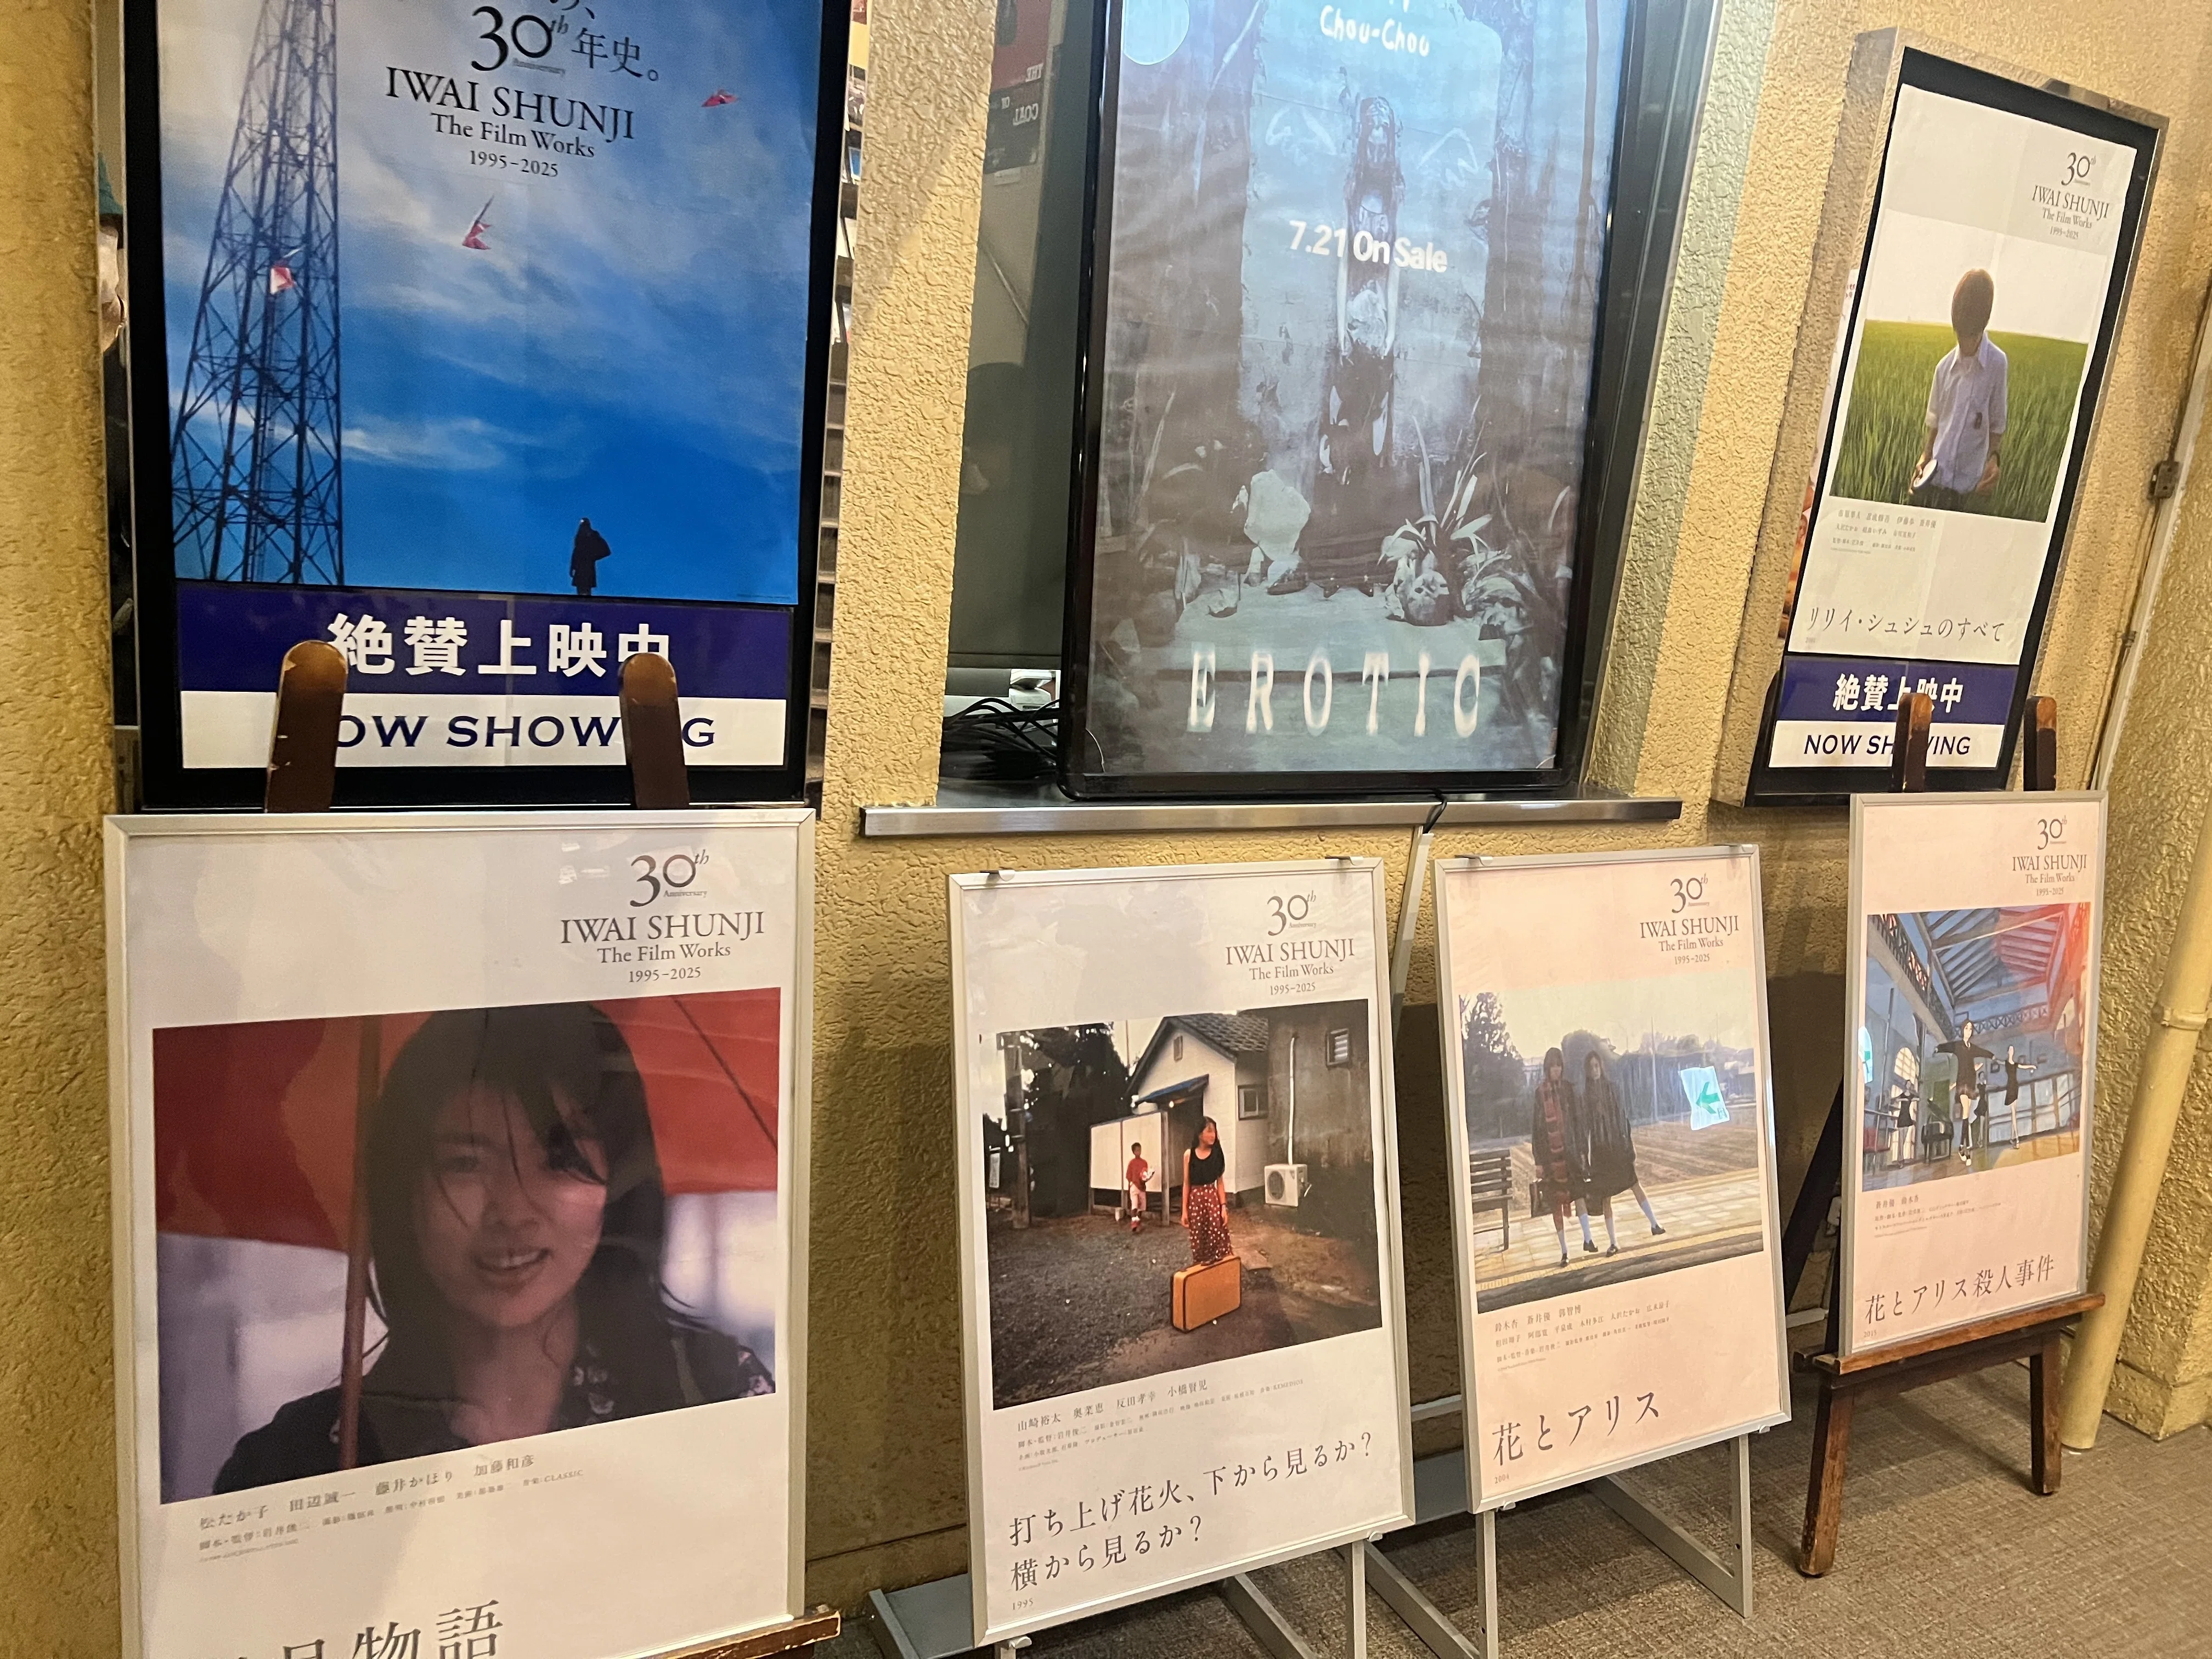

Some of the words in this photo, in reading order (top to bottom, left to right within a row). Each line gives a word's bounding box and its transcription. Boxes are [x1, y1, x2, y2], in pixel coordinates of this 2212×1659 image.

[1319, 5, 1430, 56] Chou-Chou
[572, 27, 658, 81] 年史。
[386, 66, 479, 111] IWAI
[492, 87, 635, 142] SHUNJI
[431, 113, 473, 138] The
[481, 121, 527, 147] Film
[531, 130, 595, 158] Works
[2032, 184, 2061, 207] IWAI
[2062, 192, 2110, 221] SHUNJI
[2042, 207, 2055, 221] The
[2057, 211, 2071, 224] Film
[2073, 215, 2092, 229] Works
[1289, 220, 1346, 257] 7.21
[1353, 230, 1391, 264] On
[1394, 237, 1448, 273] Sale
[1807, 607, 2005, 642] リリイ・シュシュのすべて
[1832, 673, 1964, 713] 絶賛上映中
[336, 715, 426, 747] OW
[447, 715, 716, 748] SHOWG
[1804, 735, 1863, 755] NOW
[1866, 735, 1971, 755] SHING
[630, 849, 709, 907] 30th
[2012, 855, 2040, 871] IWAI
[2044, 854, 2087, 872] SHUNJI
[2025, 873, 2038, 884] The
[2040, 873, 2055, 883] Film
[2056, 872, 2075, 882] Works
[1670, 872, 1708, 913] 30th
[561, 917, 636, 944] IWAI
[647, 911, 765, 941] SHUNJI
[1267, 890, 1316, 936] 30th
[1640, 920, 1677, 939] IWAI
[1681, 916, 1739, 936] SHUNJI
[597, 947, 632, 964] The
[637, 944, 675, 961] Film
[679, 941, 731, 959] Works
[1225, 944, 1274, 965] IWAI
[1280, 938, 1355, 962] SHUNJI
[1658, 940, 1675, 951] The
[1678, 939, 1697, 950] Film
[1699, 936, 1724, 949] Works
[1249, 968, 1271, 980] The
[1275, 965, 1299, 978] Film
[1301, 962, 1334, 975] Works
[1865, 1254, 2055, 1324] 花とアリス殺人事件
[1492, 1392, 1659, 1466] 花とアリス
[1011, 1516, 1201, 1592] 横から見るか？
[1012, 1598, 1034, 1611] 1995
